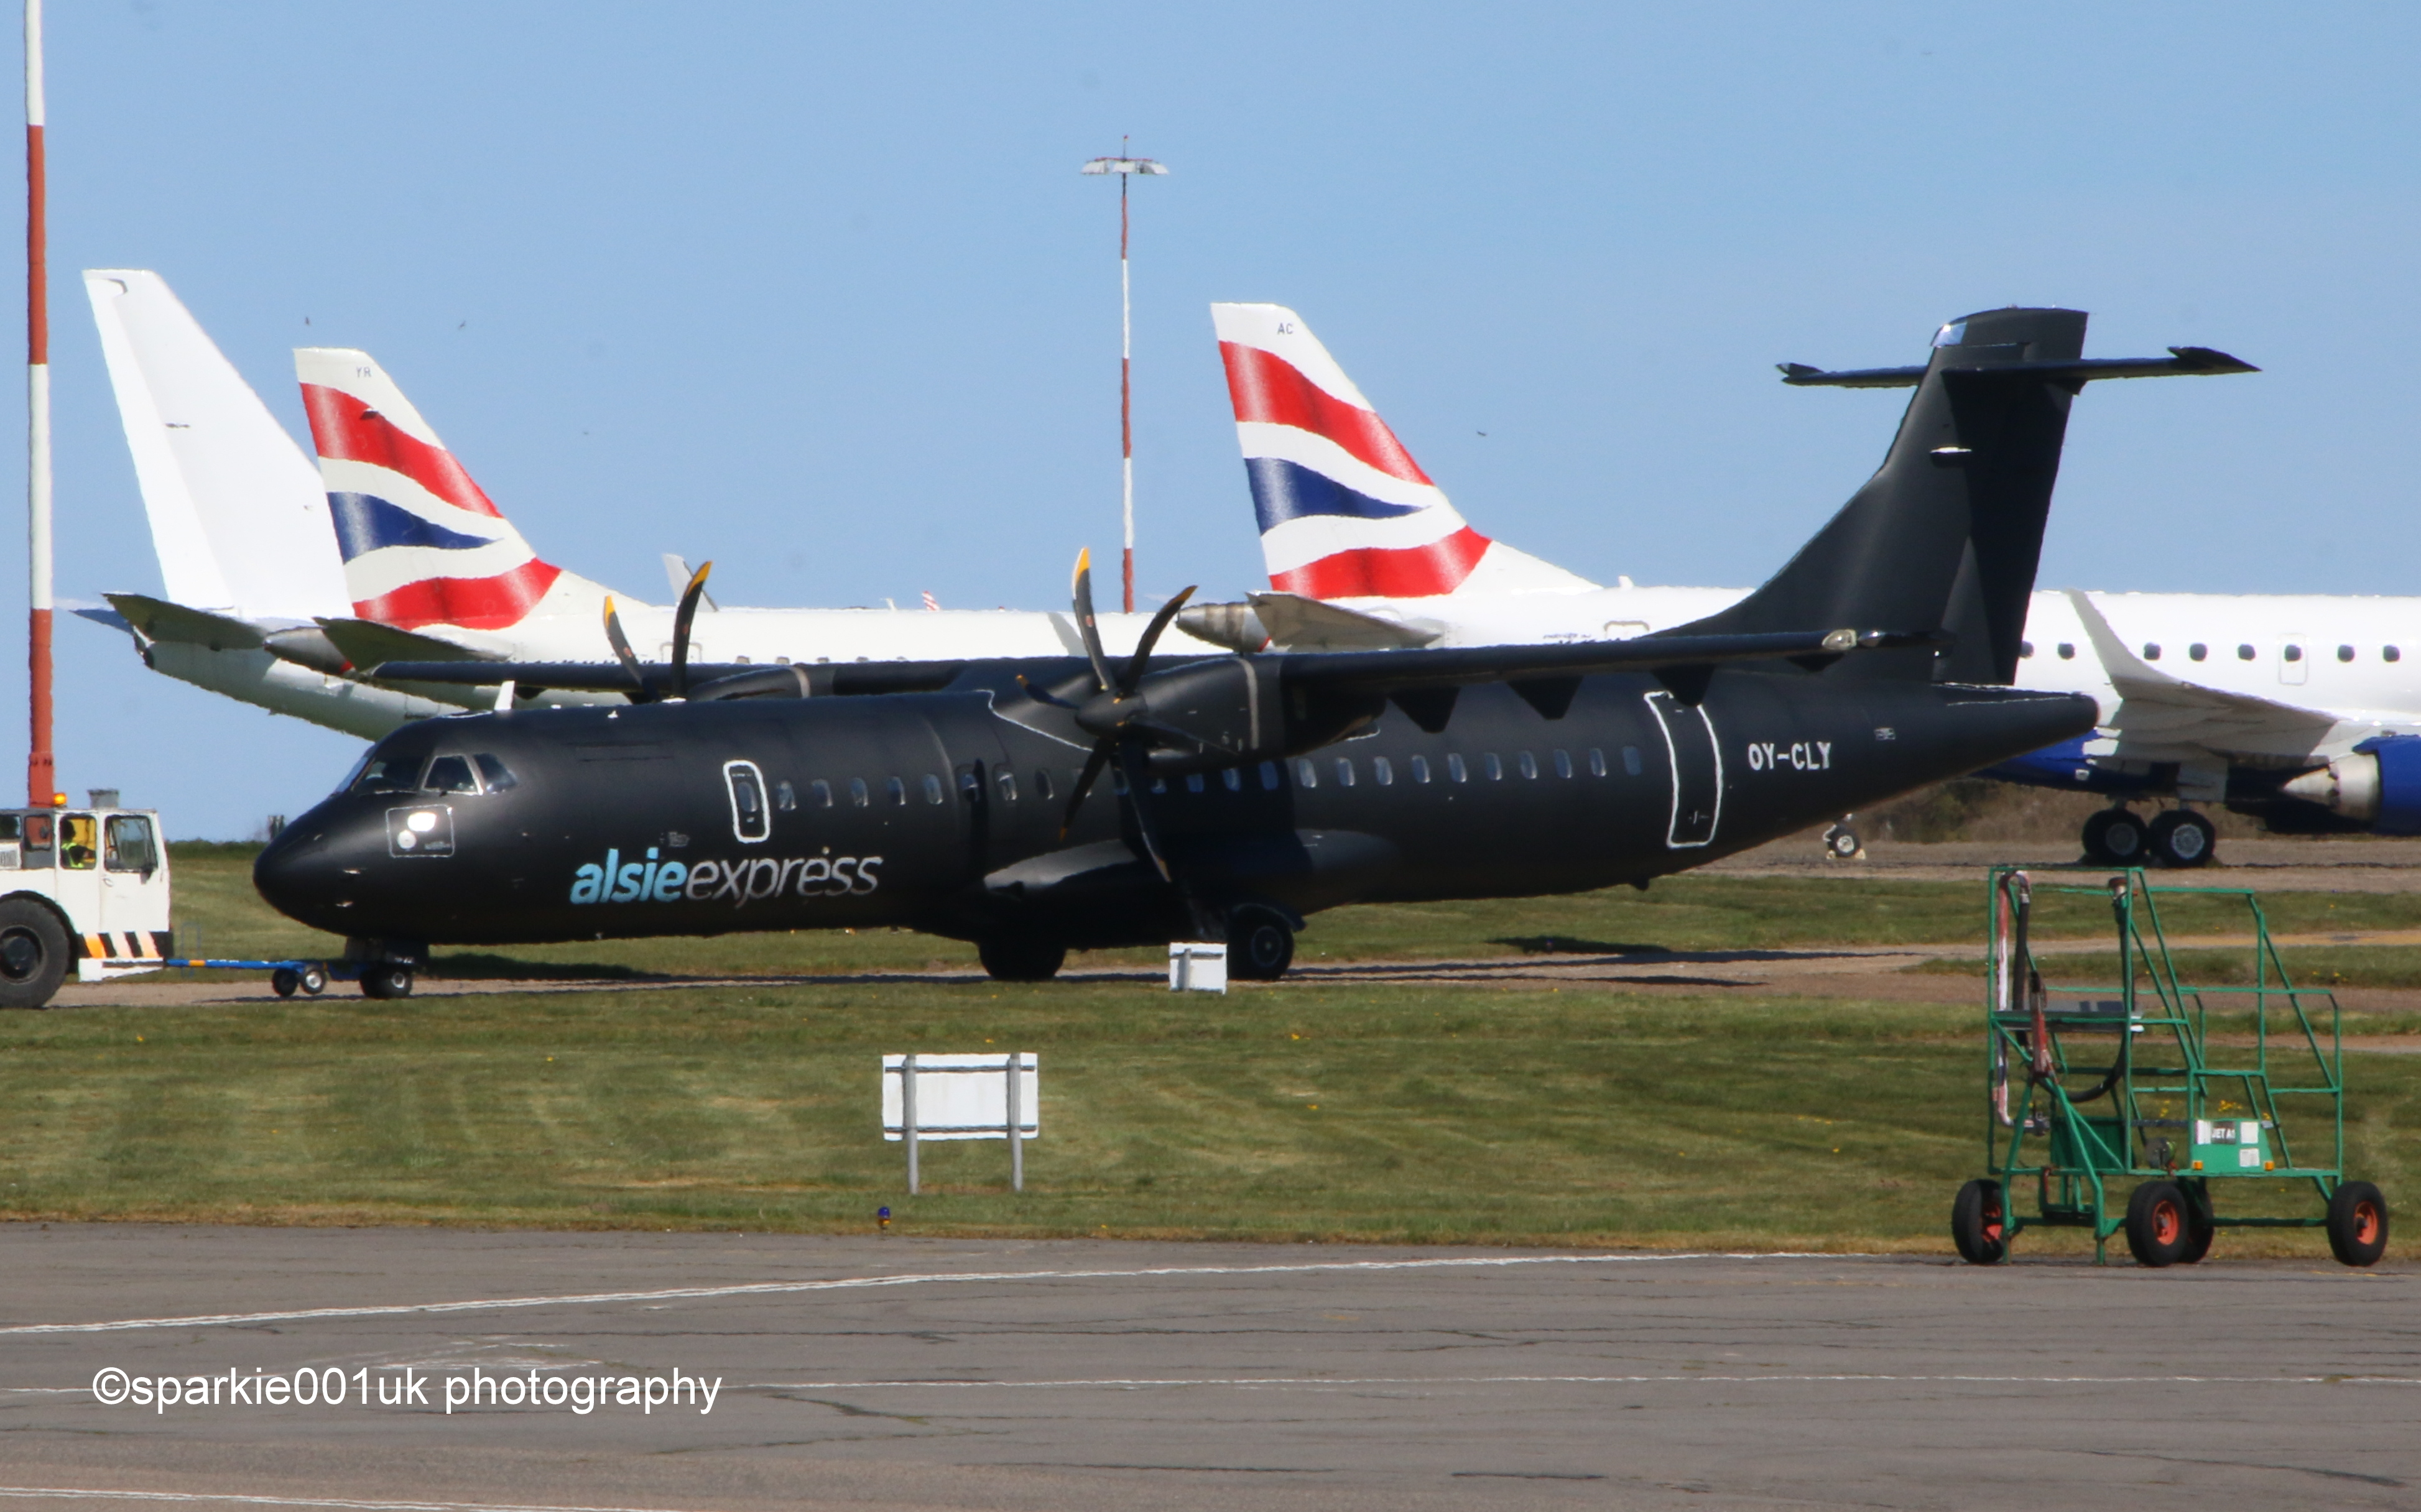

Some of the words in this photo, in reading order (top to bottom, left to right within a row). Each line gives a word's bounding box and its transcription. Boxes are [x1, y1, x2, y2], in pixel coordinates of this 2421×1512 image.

[1277, 322, 1294, 335] AC
[356, 366, 372, 378] YR
[1747, 741, 1831, 771] OY-CLY
